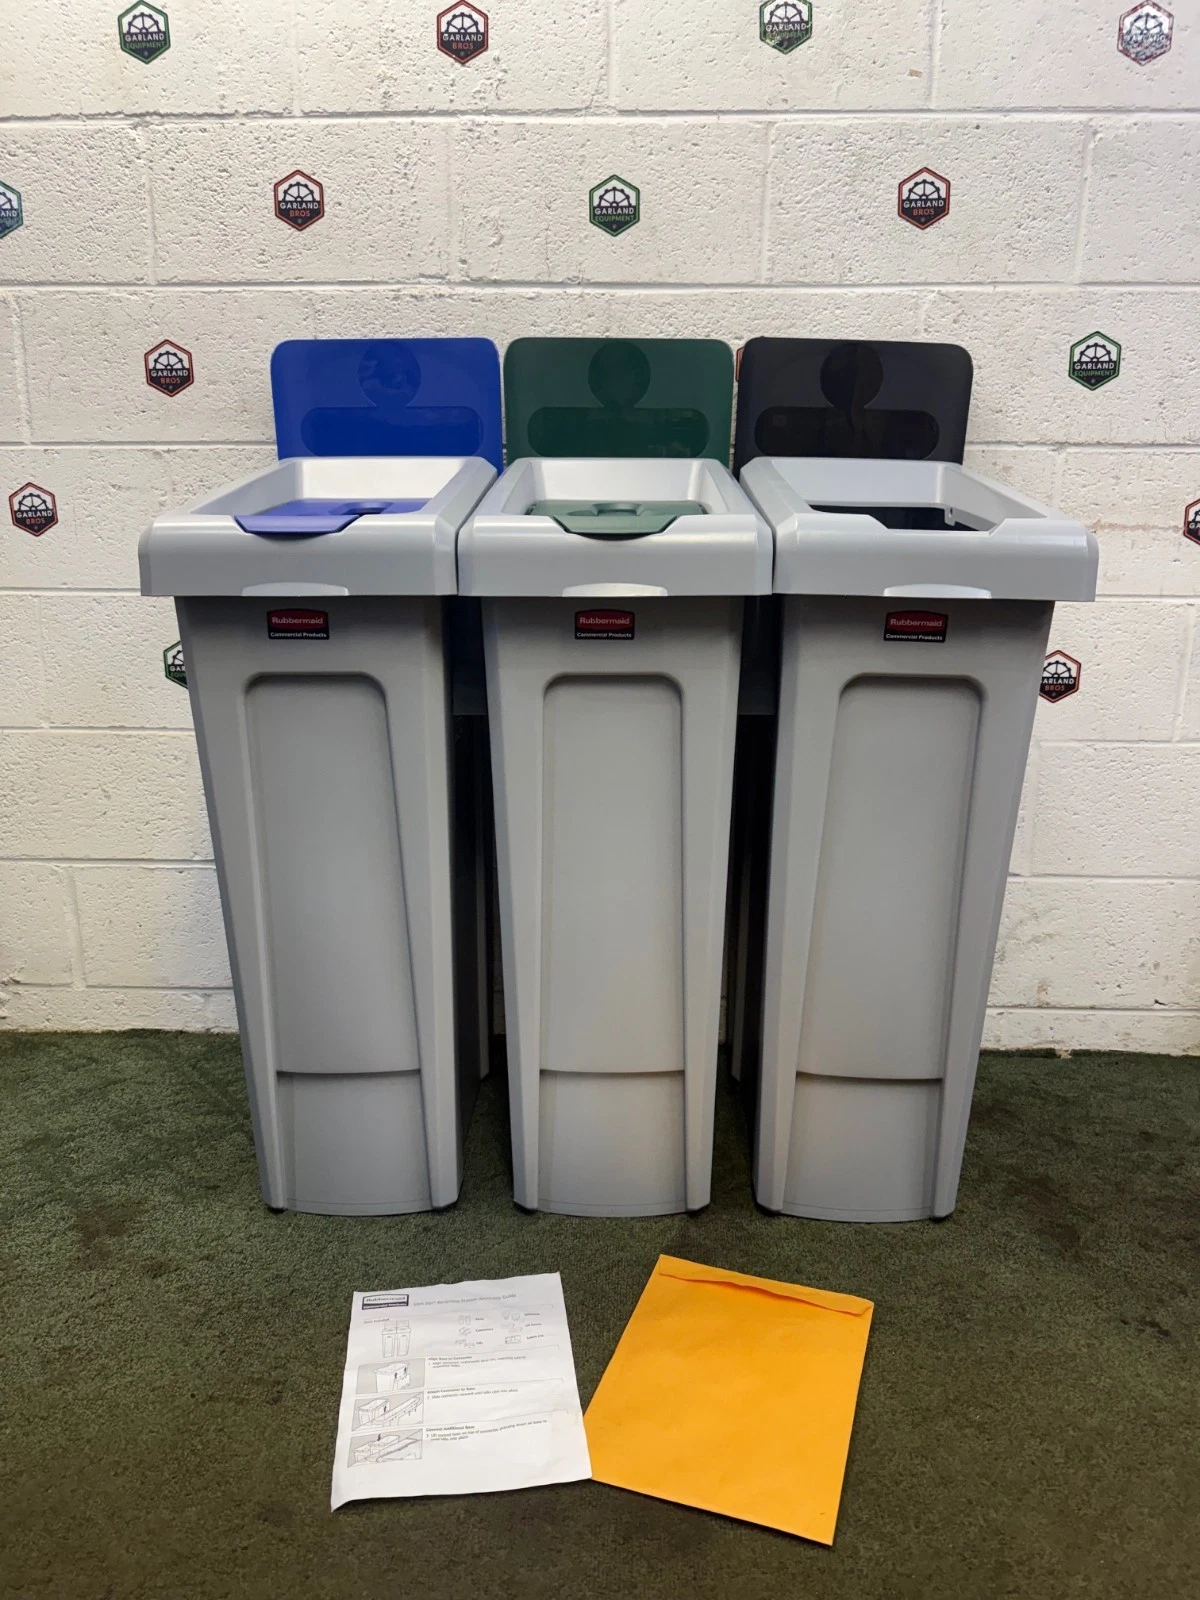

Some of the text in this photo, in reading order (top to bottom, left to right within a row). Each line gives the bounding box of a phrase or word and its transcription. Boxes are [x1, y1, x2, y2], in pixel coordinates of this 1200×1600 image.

[766, 24, 807, 32] GARLAND
[125, 33, 165, 42] GARLAND
[443, 34, 483, 42] GARLAND
[126, 42, 165, 50] EQUIPMENT
[280, 202, 319, 210] GARLAND
[903, 200, 944, 208] GARLAND
[594, 207, 635, 215] GARLAND
[913, 208, 935, 216] BROS
[1074, 362, 1115, 370] GARLAND
[16, 510, 53, 518] GARLAND
[272, 616, 323, 624] Rubbermaid
[890, 618, 943, 627] Rubbermaid
